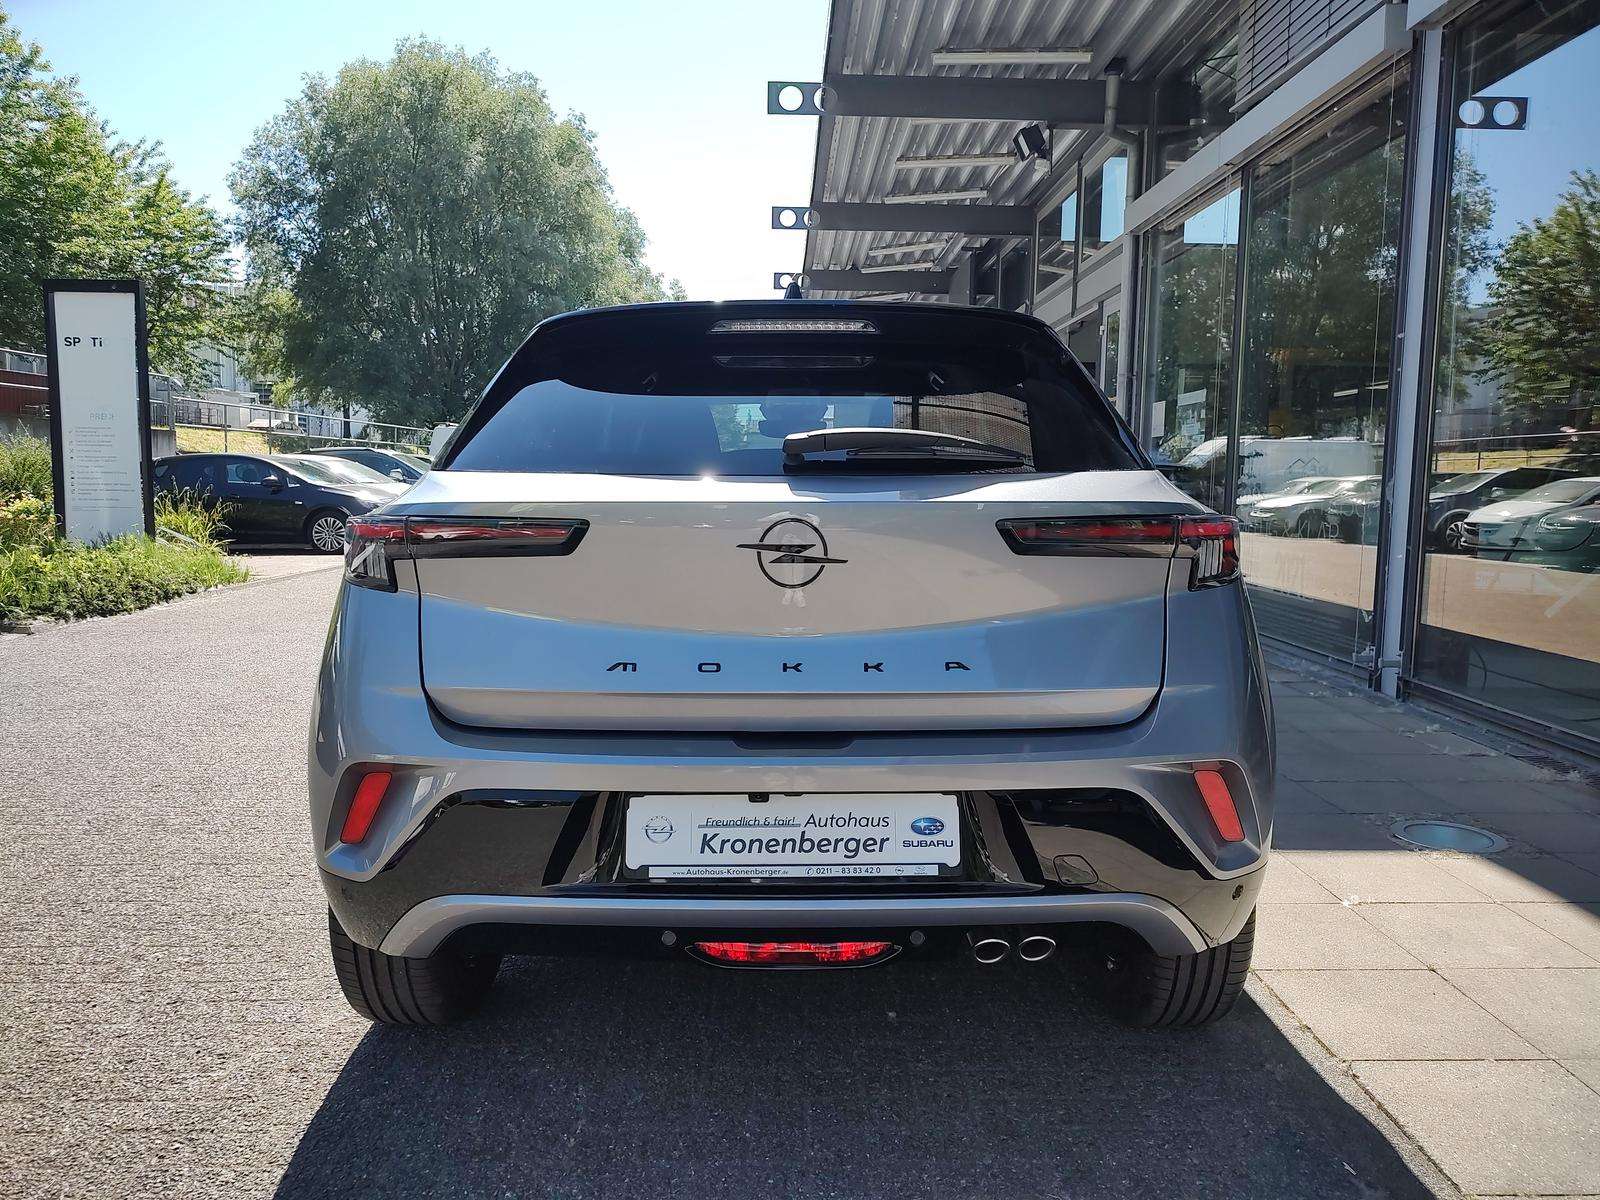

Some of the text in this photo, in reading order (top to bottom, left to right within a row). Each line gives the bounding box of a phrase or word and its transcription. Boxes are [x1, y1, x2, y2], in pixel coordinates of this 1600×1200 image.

[606, 661, 971, 673] MOKKA
[705, 815, 796, 827] Freundlich & fair!
[804, 811, 890, 828] Autohaus
[699, 830, 890, 859] Kronenberger
[902, 839, 954, 848] SUBARU
[672, 867, 789, 876] www.Autohaus-Kronenberger.de
[815, 867, 833, 875] 0211
[841, 867, 851, 875] 83
[853, 867, 863, 875] 83
[864, 867, 874, 875] 42
[875, 867, 881, 875] 0
